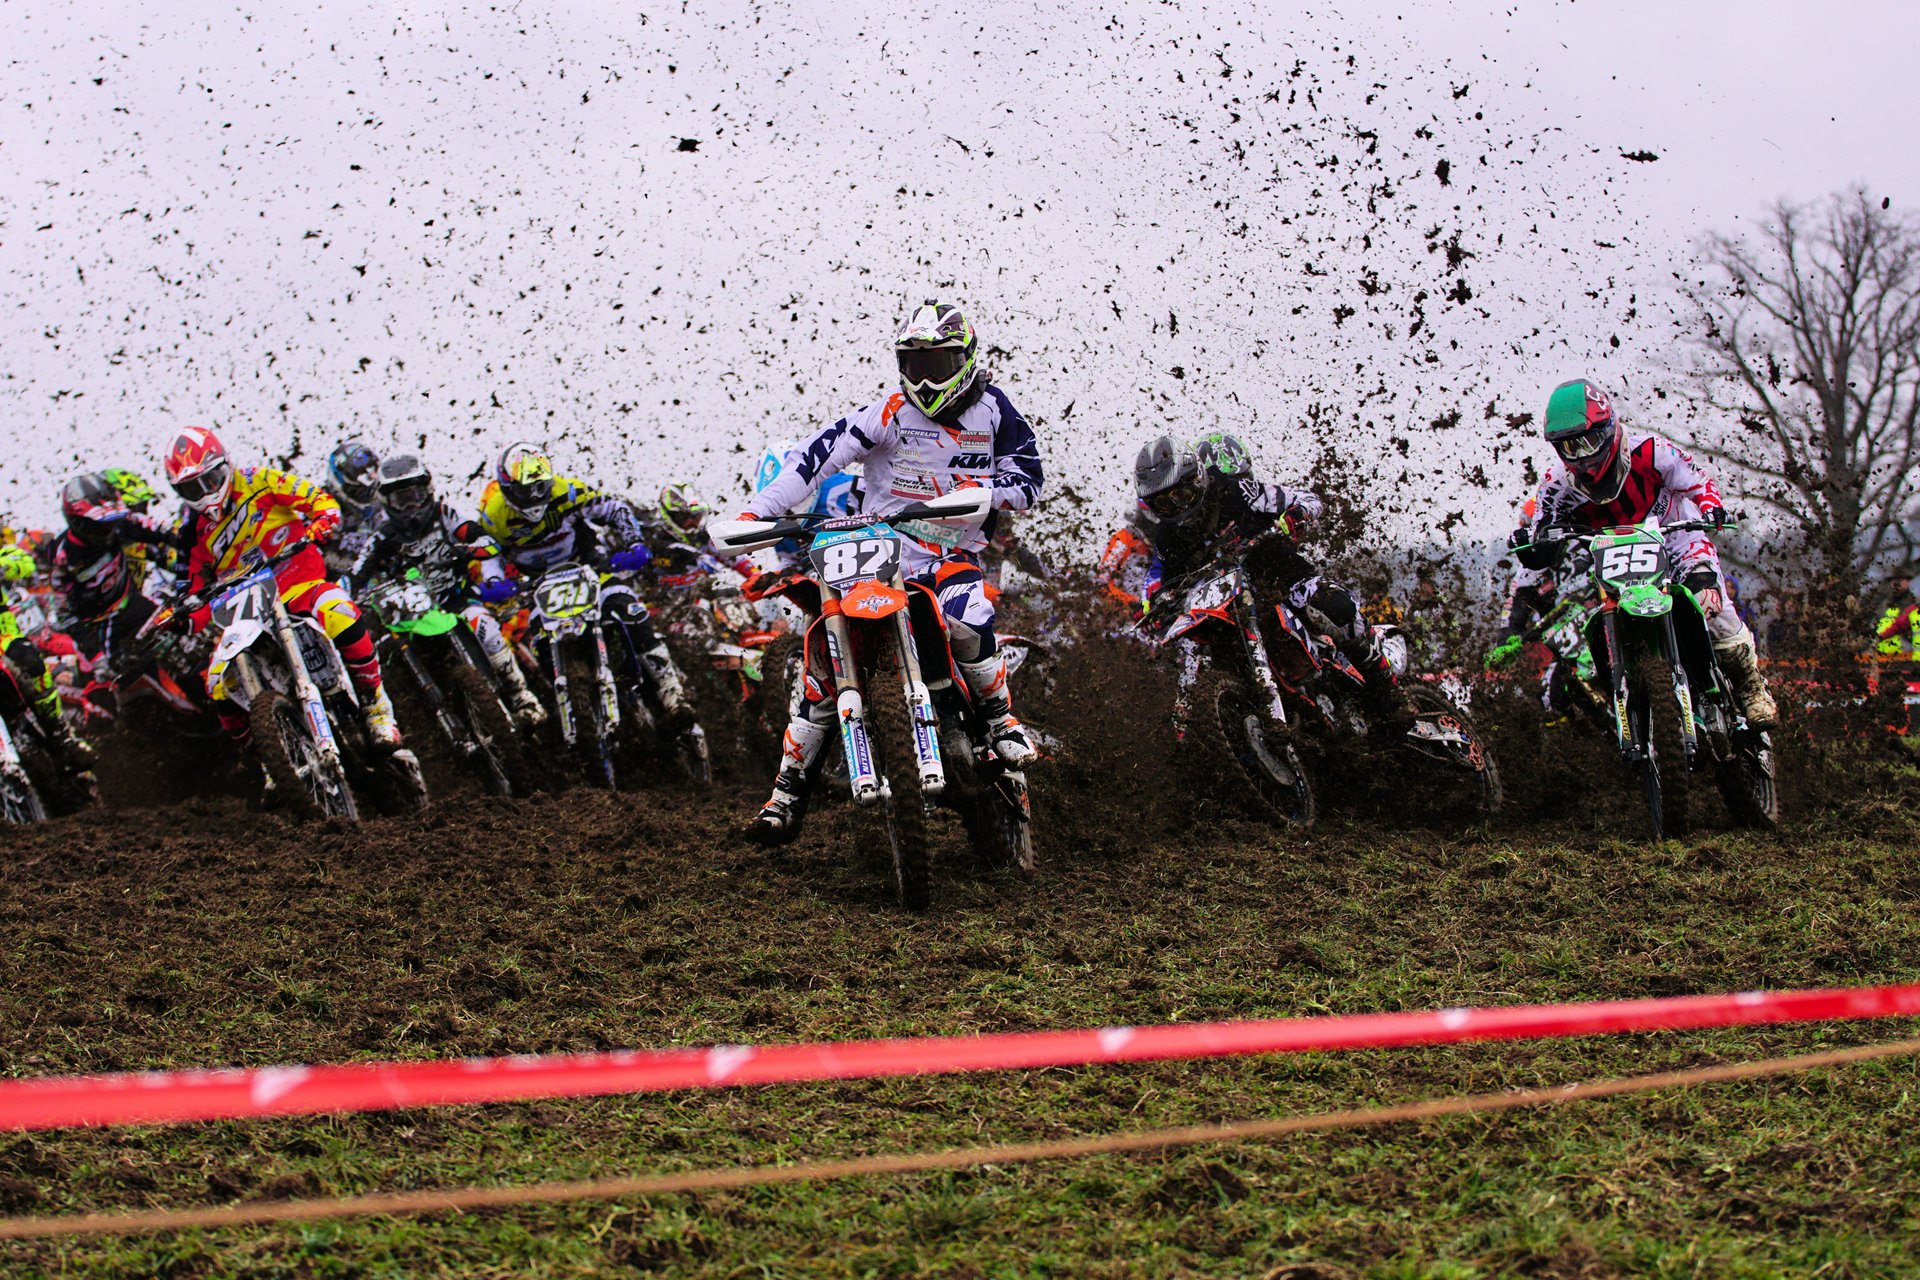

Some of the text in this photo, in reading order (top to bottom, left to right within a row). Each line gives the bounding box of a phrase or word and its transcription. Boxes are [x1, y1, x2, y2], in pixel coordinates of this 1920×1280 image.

[900, 428, 939, 438] MICHELIN
[948, 453, 991, 469] KTM
[825, 517, 875, 529] RENTHAL
[828, 531, 870, 543] MOTOEX
[823, 539, 894, 582] 82
[1602, 544, 1660, 580] 55
[916, 706, 928, 749] MICHIN
[857, 728, 870, 773] MICHELIN
